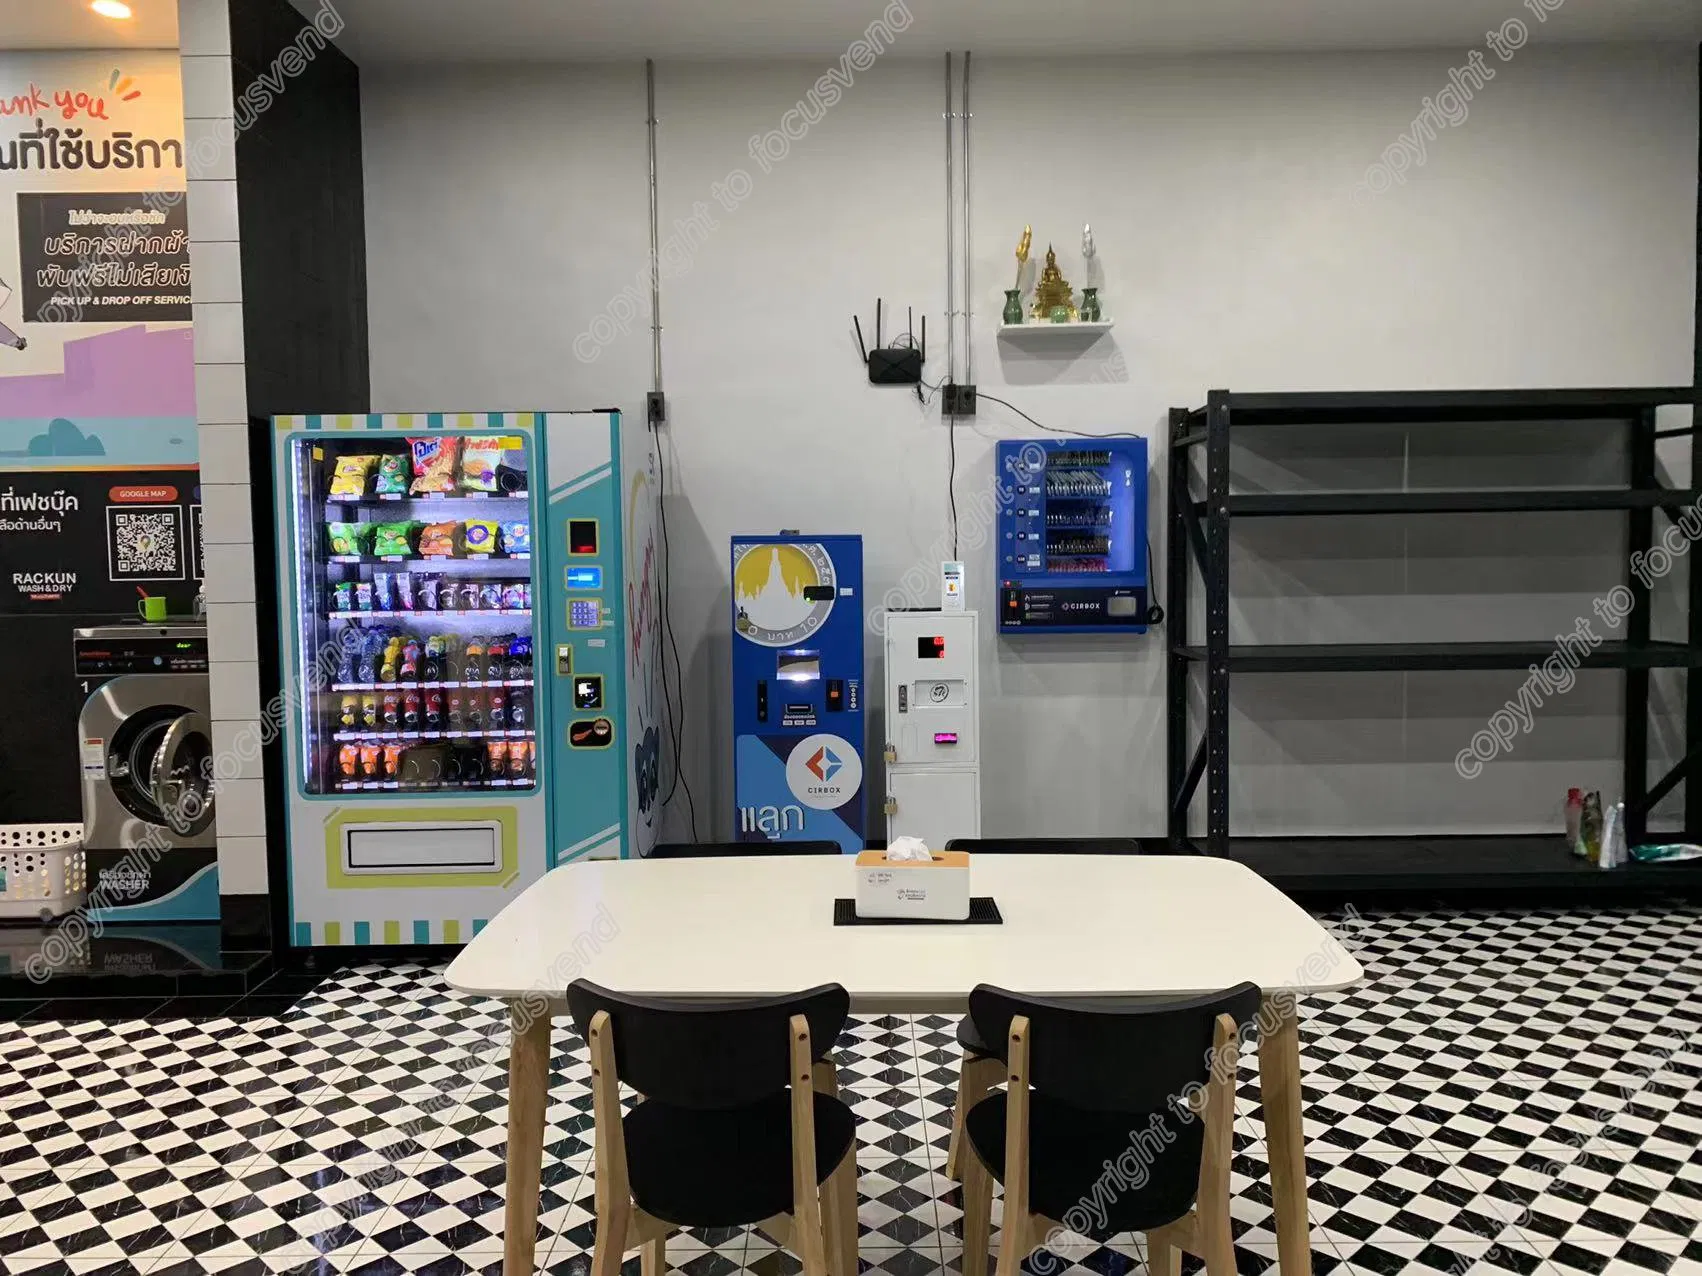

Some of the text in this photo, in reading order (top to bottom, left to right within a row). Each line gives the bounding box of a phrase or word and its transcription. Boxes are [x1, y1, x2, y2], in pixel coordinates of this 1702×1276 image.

[54, 90, 109, 120] you
[50, 295, 192, 306] PICK UP & DROP OFF SERVIC
[119, 489, 167, 498] GOOGLE MAP
[13, 573, 77, 584] RACKUN
[1070, 602, 1100, 610] CIRBOX
[80, 681, 89, 694] 1
[100, 880, 151, 891] WASHER
